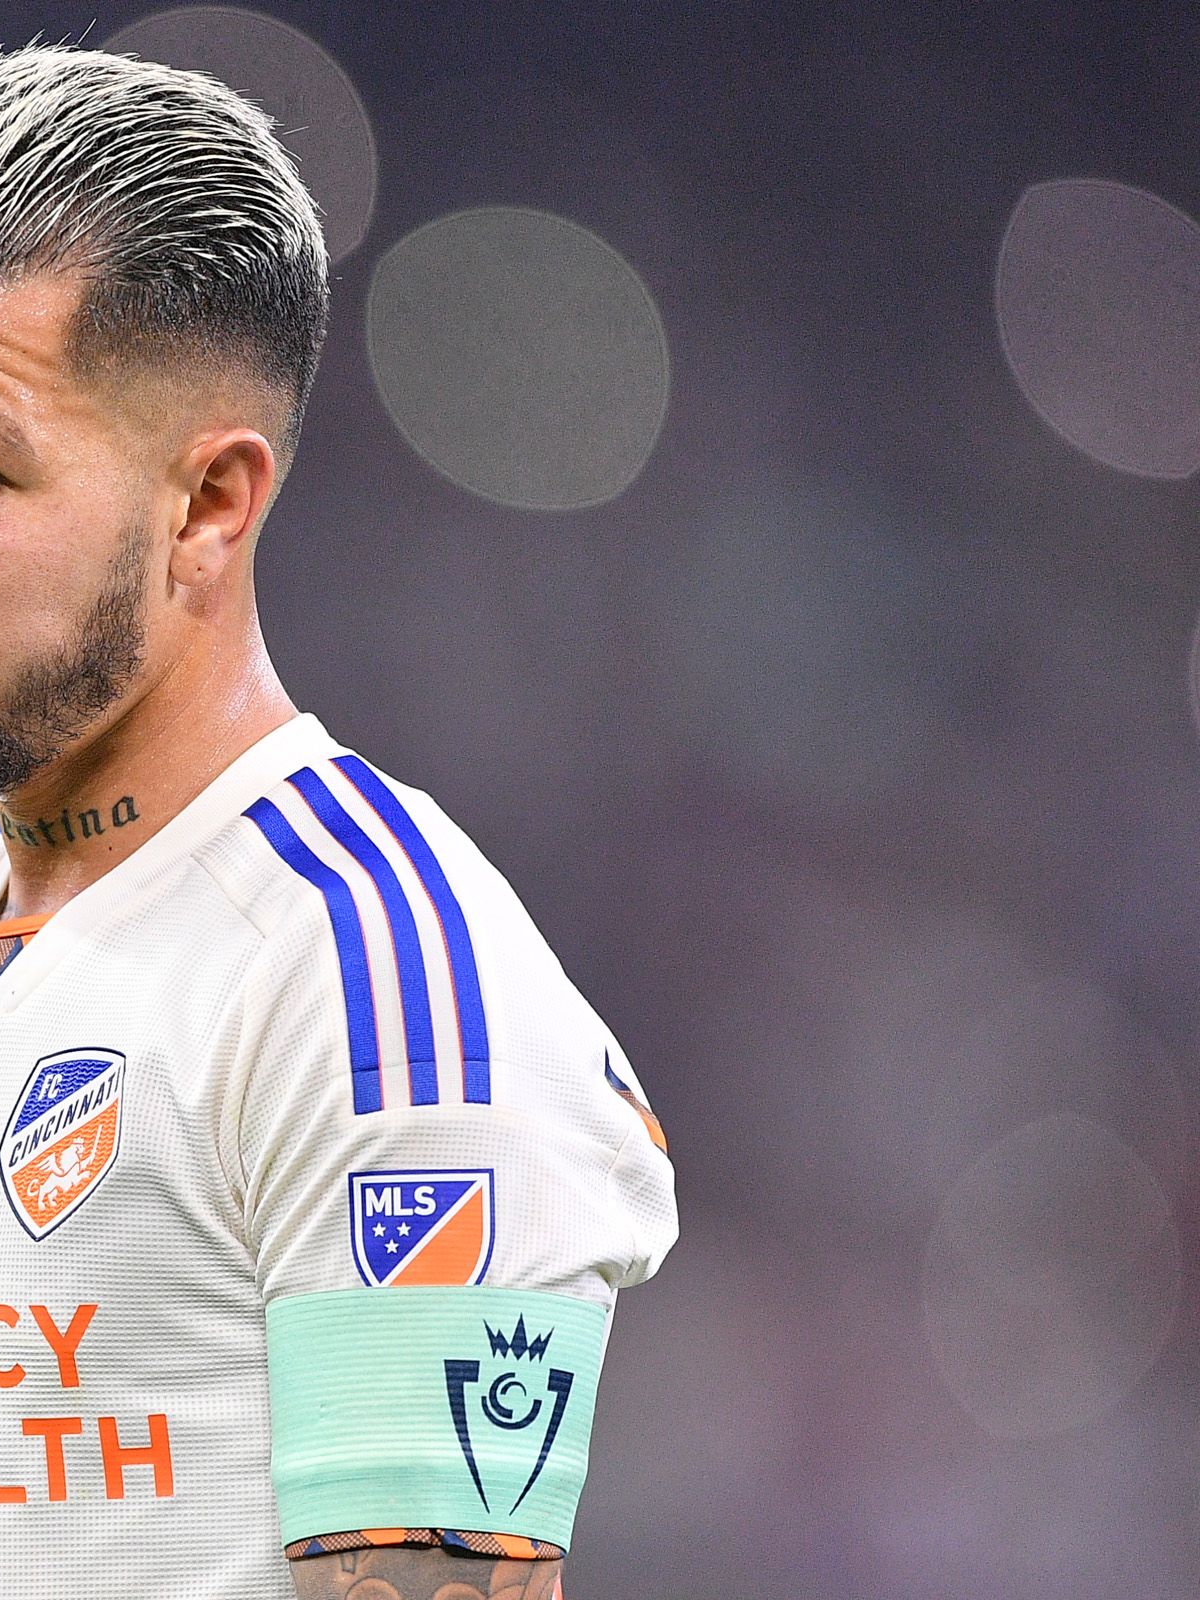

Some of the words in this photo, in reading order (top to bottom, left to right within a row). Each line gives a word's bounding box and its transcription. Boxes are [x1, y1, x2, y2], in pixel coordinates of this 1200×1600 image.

[37, 1073, 63, 1101] FC
[8, 1064, 122, 1168] CINCINNATI
[364, 1185, 437, 1218] MLS
